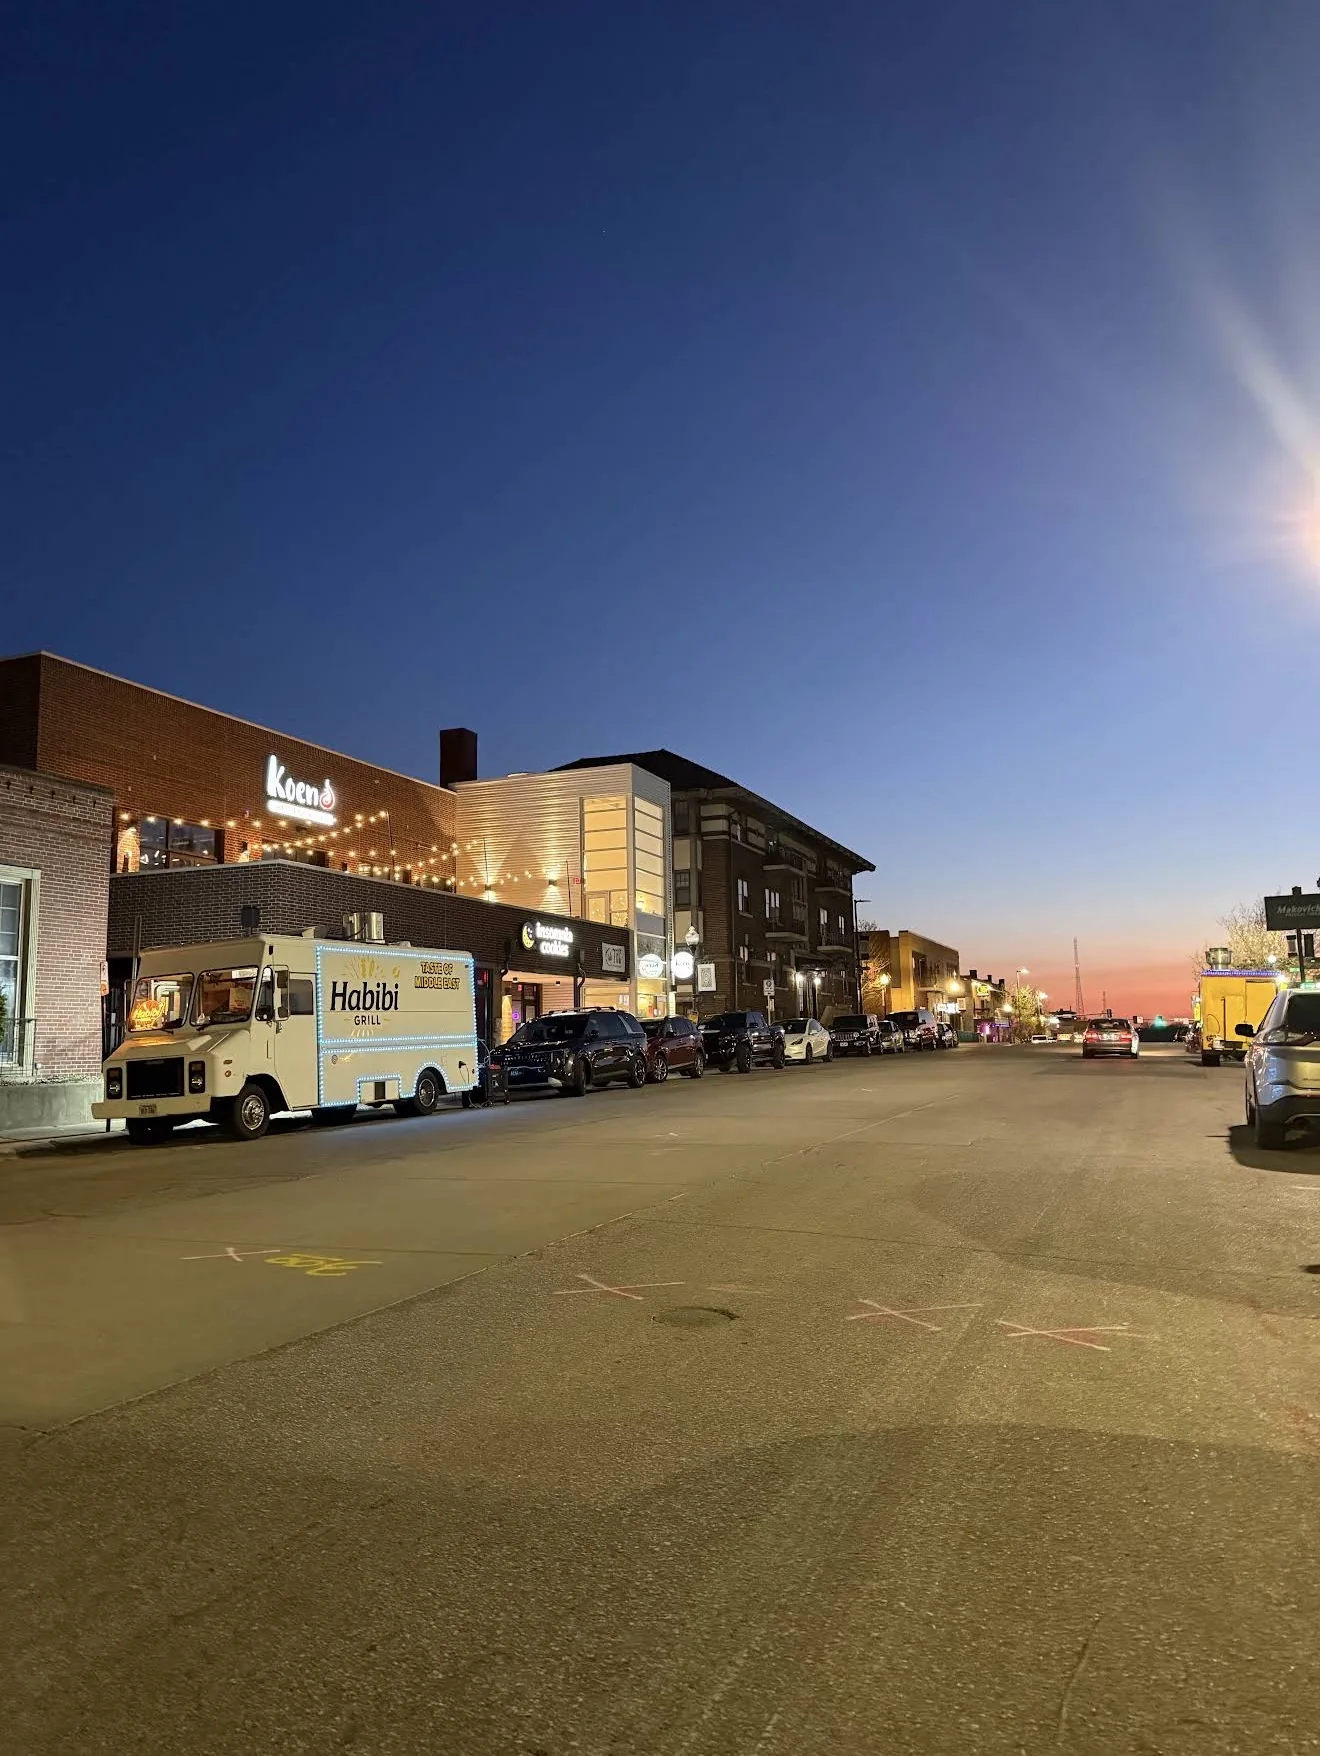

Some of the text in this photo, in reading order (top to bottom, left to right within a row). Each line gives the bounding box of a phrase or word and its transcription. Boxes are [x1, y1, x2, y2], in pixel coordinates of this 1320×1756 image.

[420, 961, 453, 975] TASTE OF
[414, 975, 460, 990] MIDDLE EAST
[330, 980, 399, 1011] Habibi
[354, 1015, 381, 1026] GRILL
